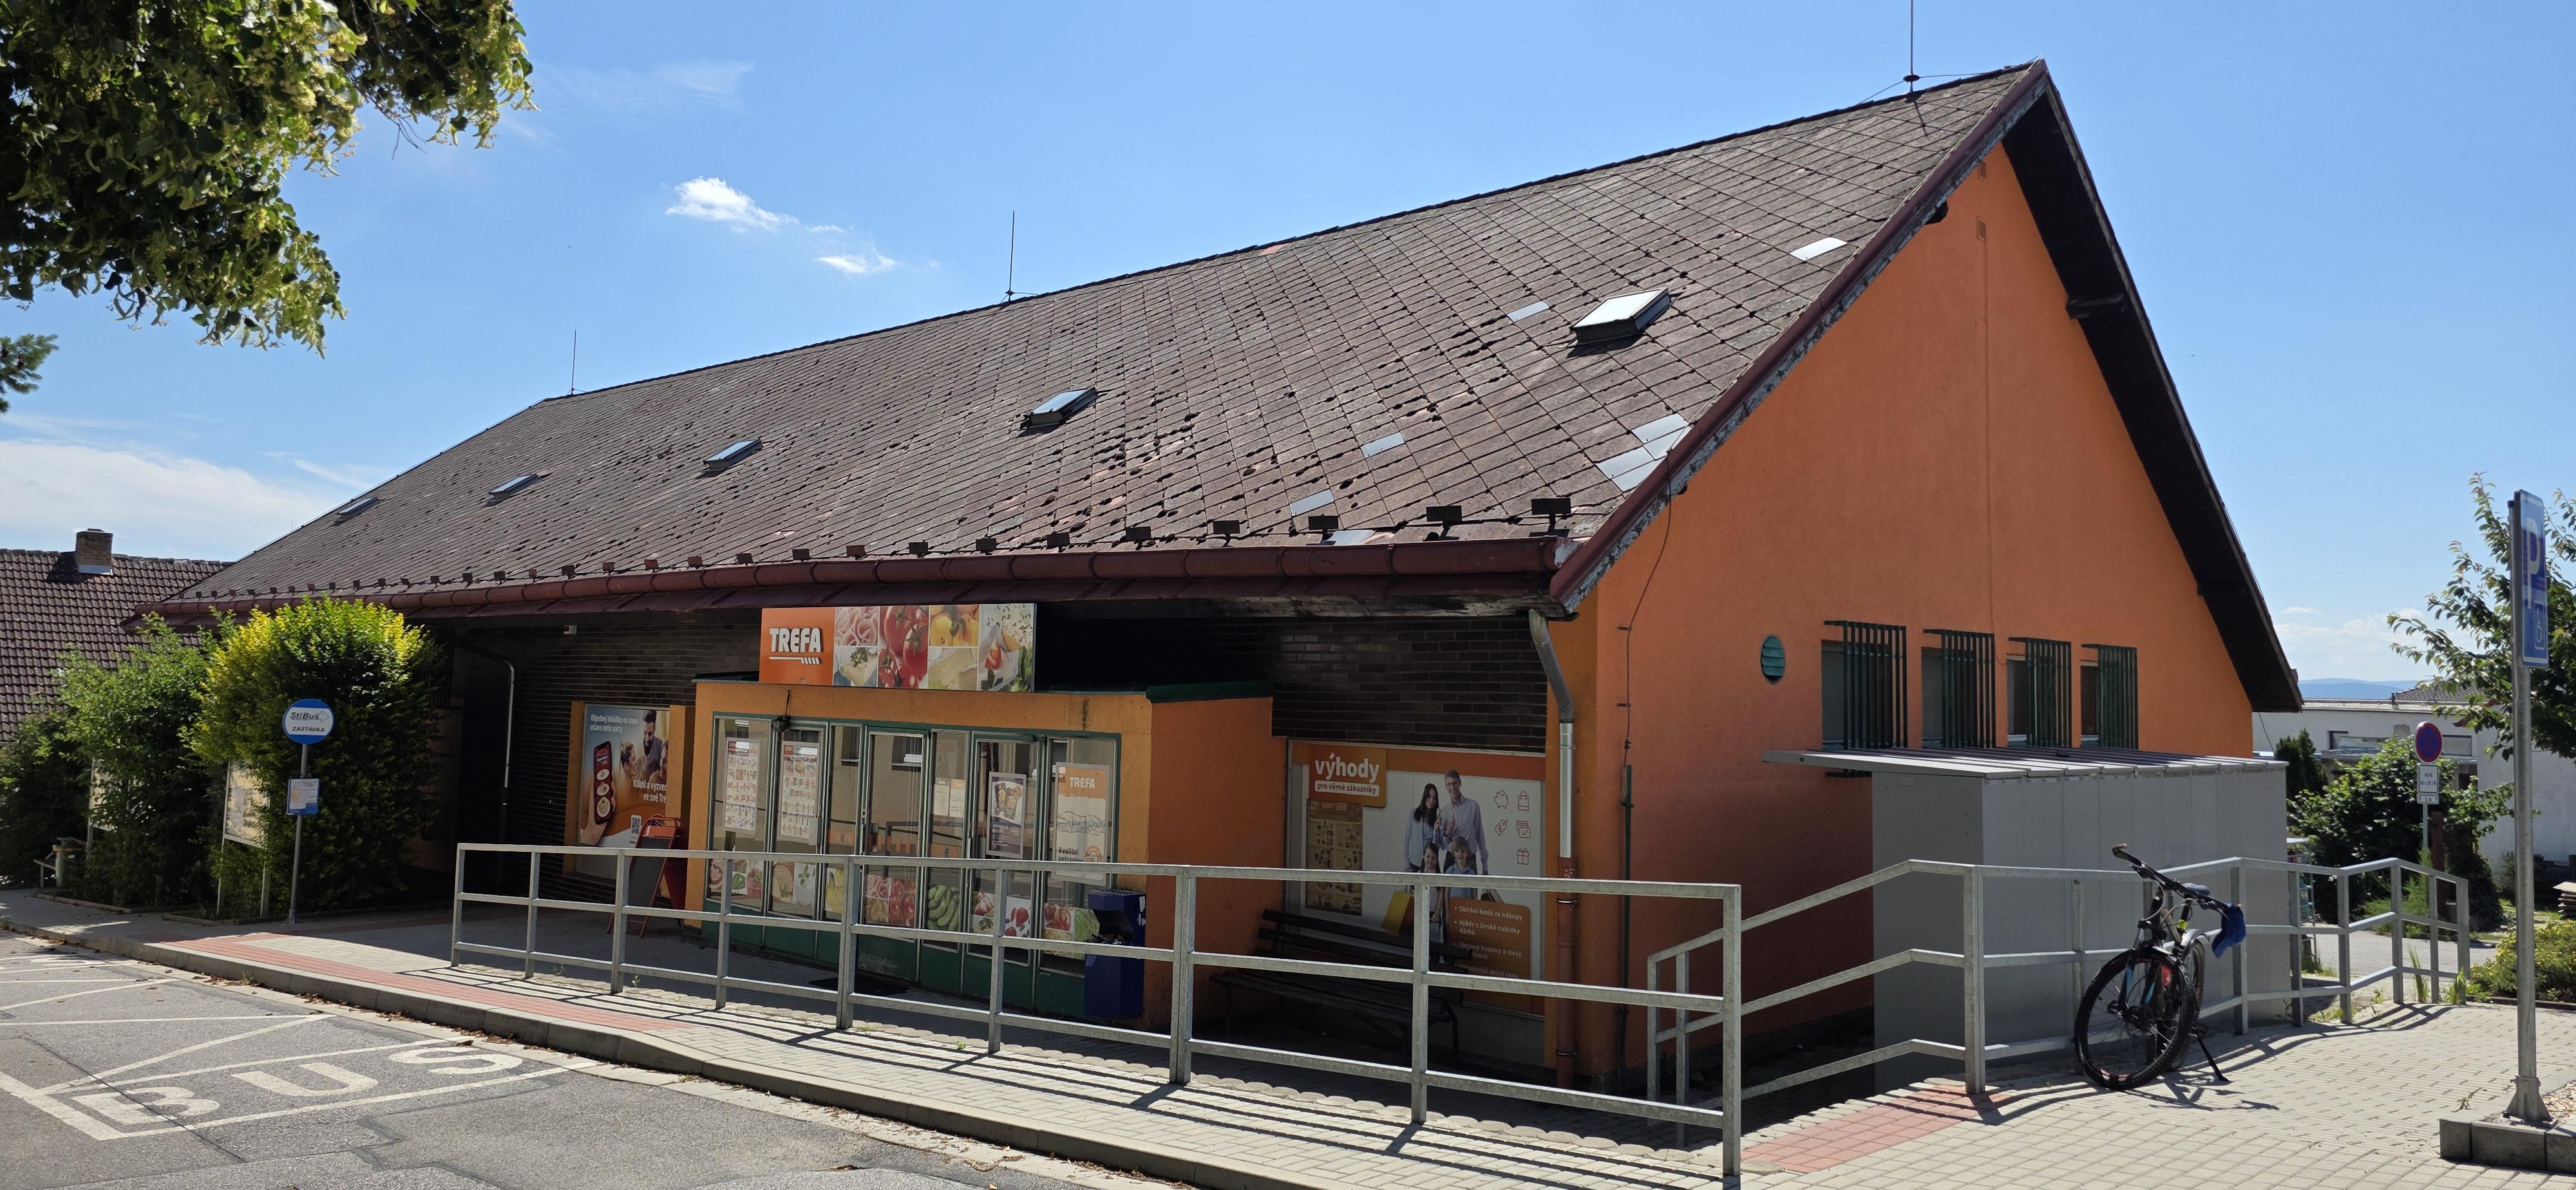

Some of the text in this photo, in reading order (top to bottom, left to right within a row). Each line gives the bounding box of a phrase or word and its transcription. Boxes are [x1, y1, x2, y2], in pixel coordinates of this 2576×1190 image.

[2526, 517, 2541, 609] P
[769, 628, 821, 652] TREFA
[1314, 752, 1380, 784] výhody
[1069, 777, 1095, 789] TREFA
[1347, 784, 1376, 795] zákazníky
[650, 793, 658, 802] své
[1058, 846, 1079, 855] Kvalitní
[1502, 912, 1523, 921] nákupy
[1480, 922, 1496, 930] široké
[1497, 926, 1520, 935] nabídky
[1481, 945, 1502, 955] kupony
[1508, 949, 1522, 958] slevy
[70, 1046, 523, 1126] BUS
